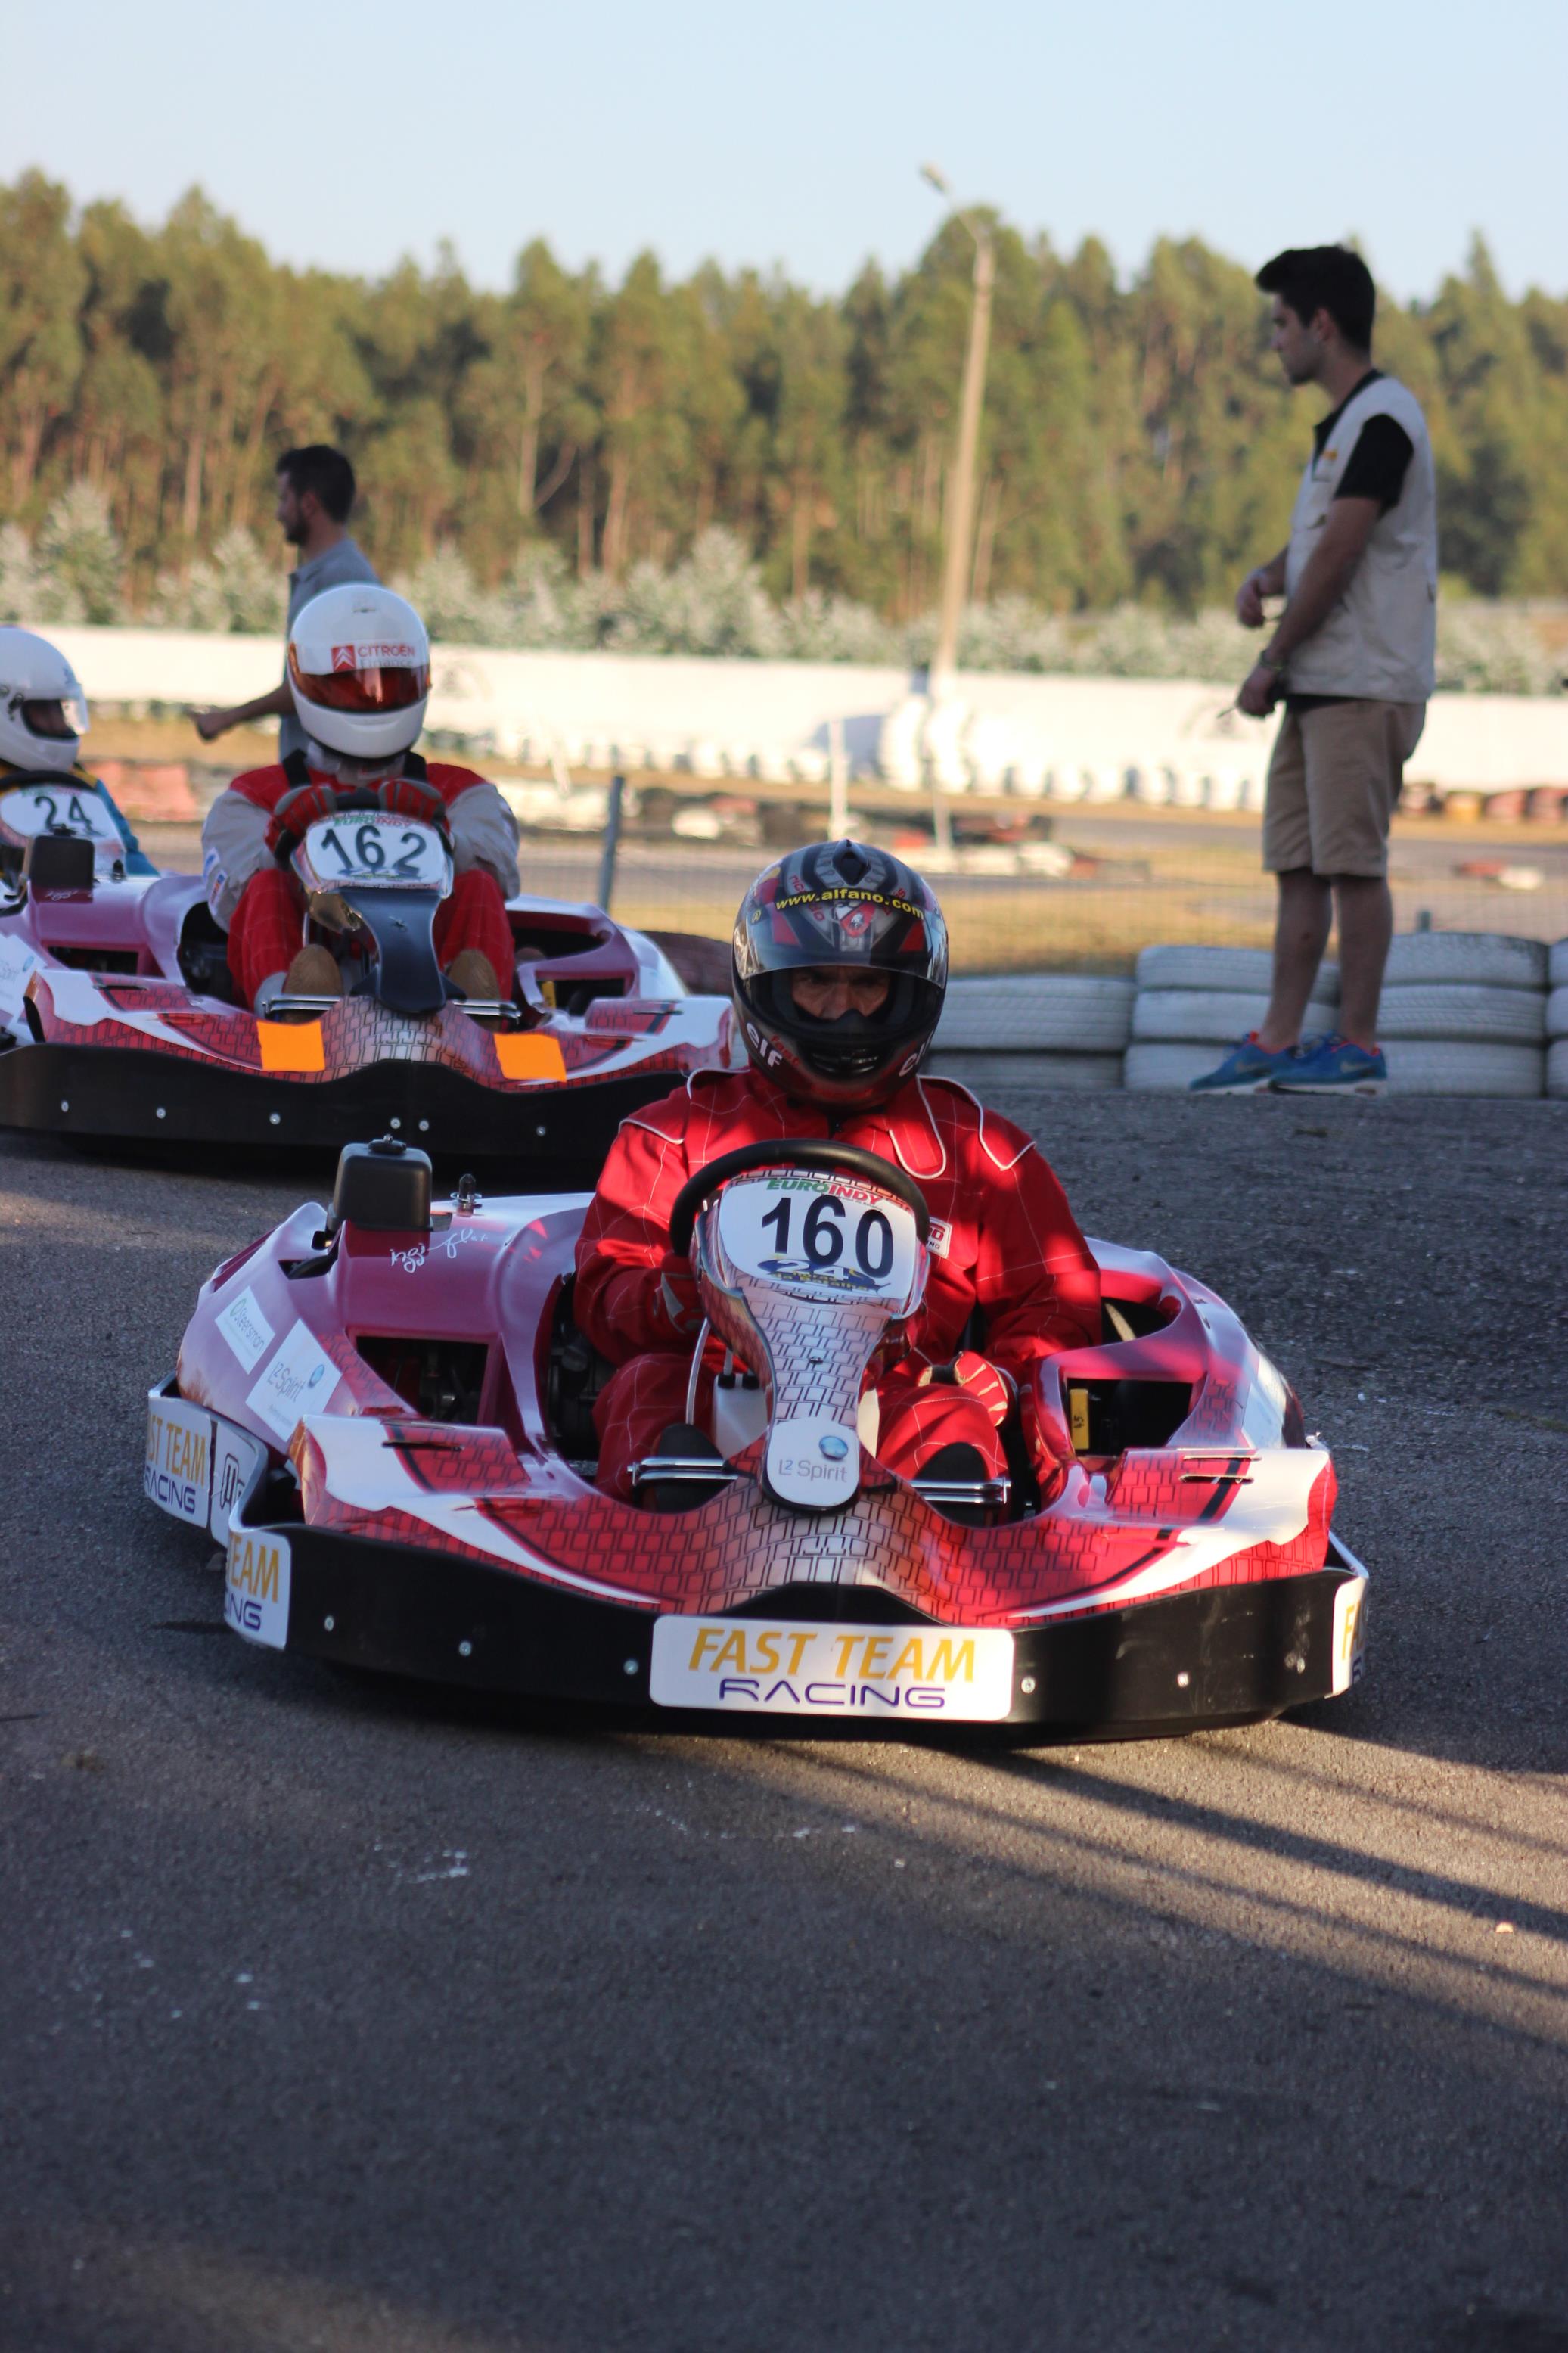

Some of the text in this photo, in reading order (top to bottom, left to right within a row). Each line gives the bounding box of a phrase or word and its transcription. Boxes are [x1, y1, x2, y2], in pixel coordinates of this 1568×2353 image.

[34, 796, 92, 836] 24
[321, 825, 427, 878] 162
[775, 887, 924, 921] www.alfano.com
[766, 1178, 883, 1206] EUROINDY
[761, 1194, 894, 1279] 160
[165, 1422, 206, 1489] TEAM
[796, 1459, 848, 1483] Spirit
[688, 1627, 975, 1683] FAST TEAM
[718, 1677, 945, 1708] RACING
